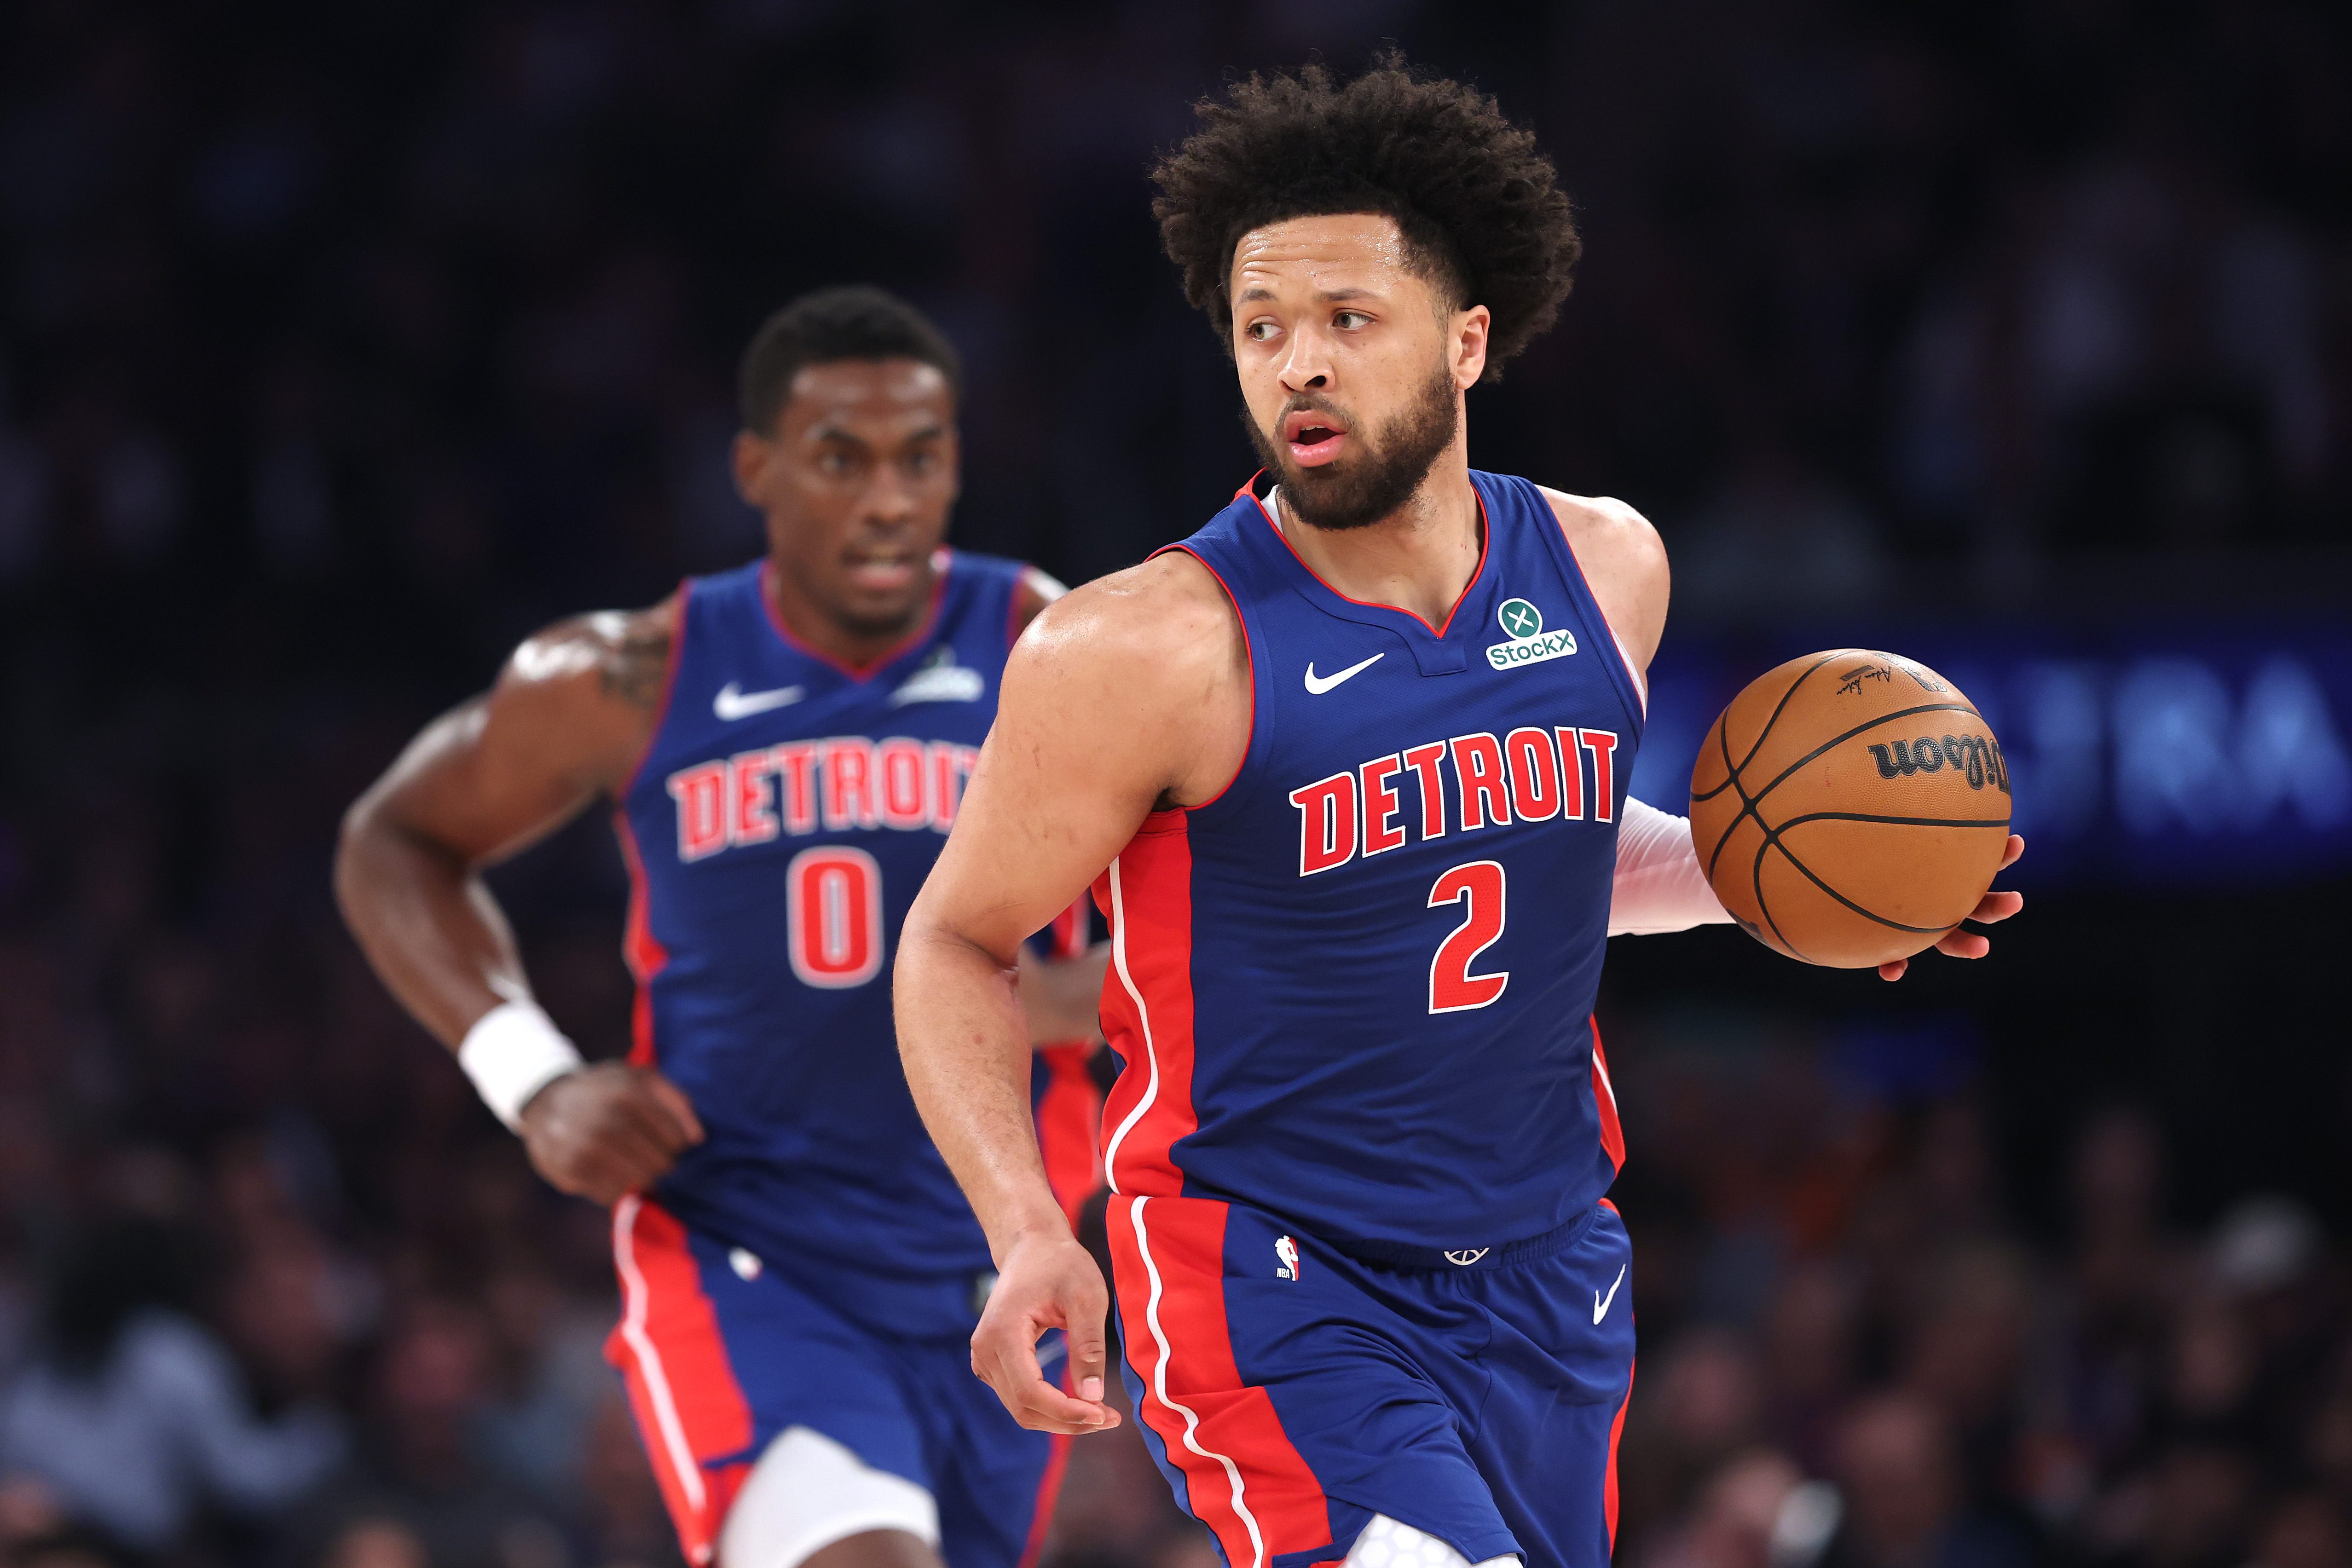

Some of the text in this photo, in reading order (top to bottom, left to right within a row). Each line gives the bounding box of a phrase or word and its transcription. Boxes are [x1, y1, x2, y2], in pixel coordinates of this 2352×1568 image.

[1490, 632, 1575, 665] StockX
[1289, 726, 1618, 877] DETROIT
[786, 845, 885, 991] 0
[1427, 860, 1509, 1015] 2
[1276, 1267, 1290, 1279] NBA
